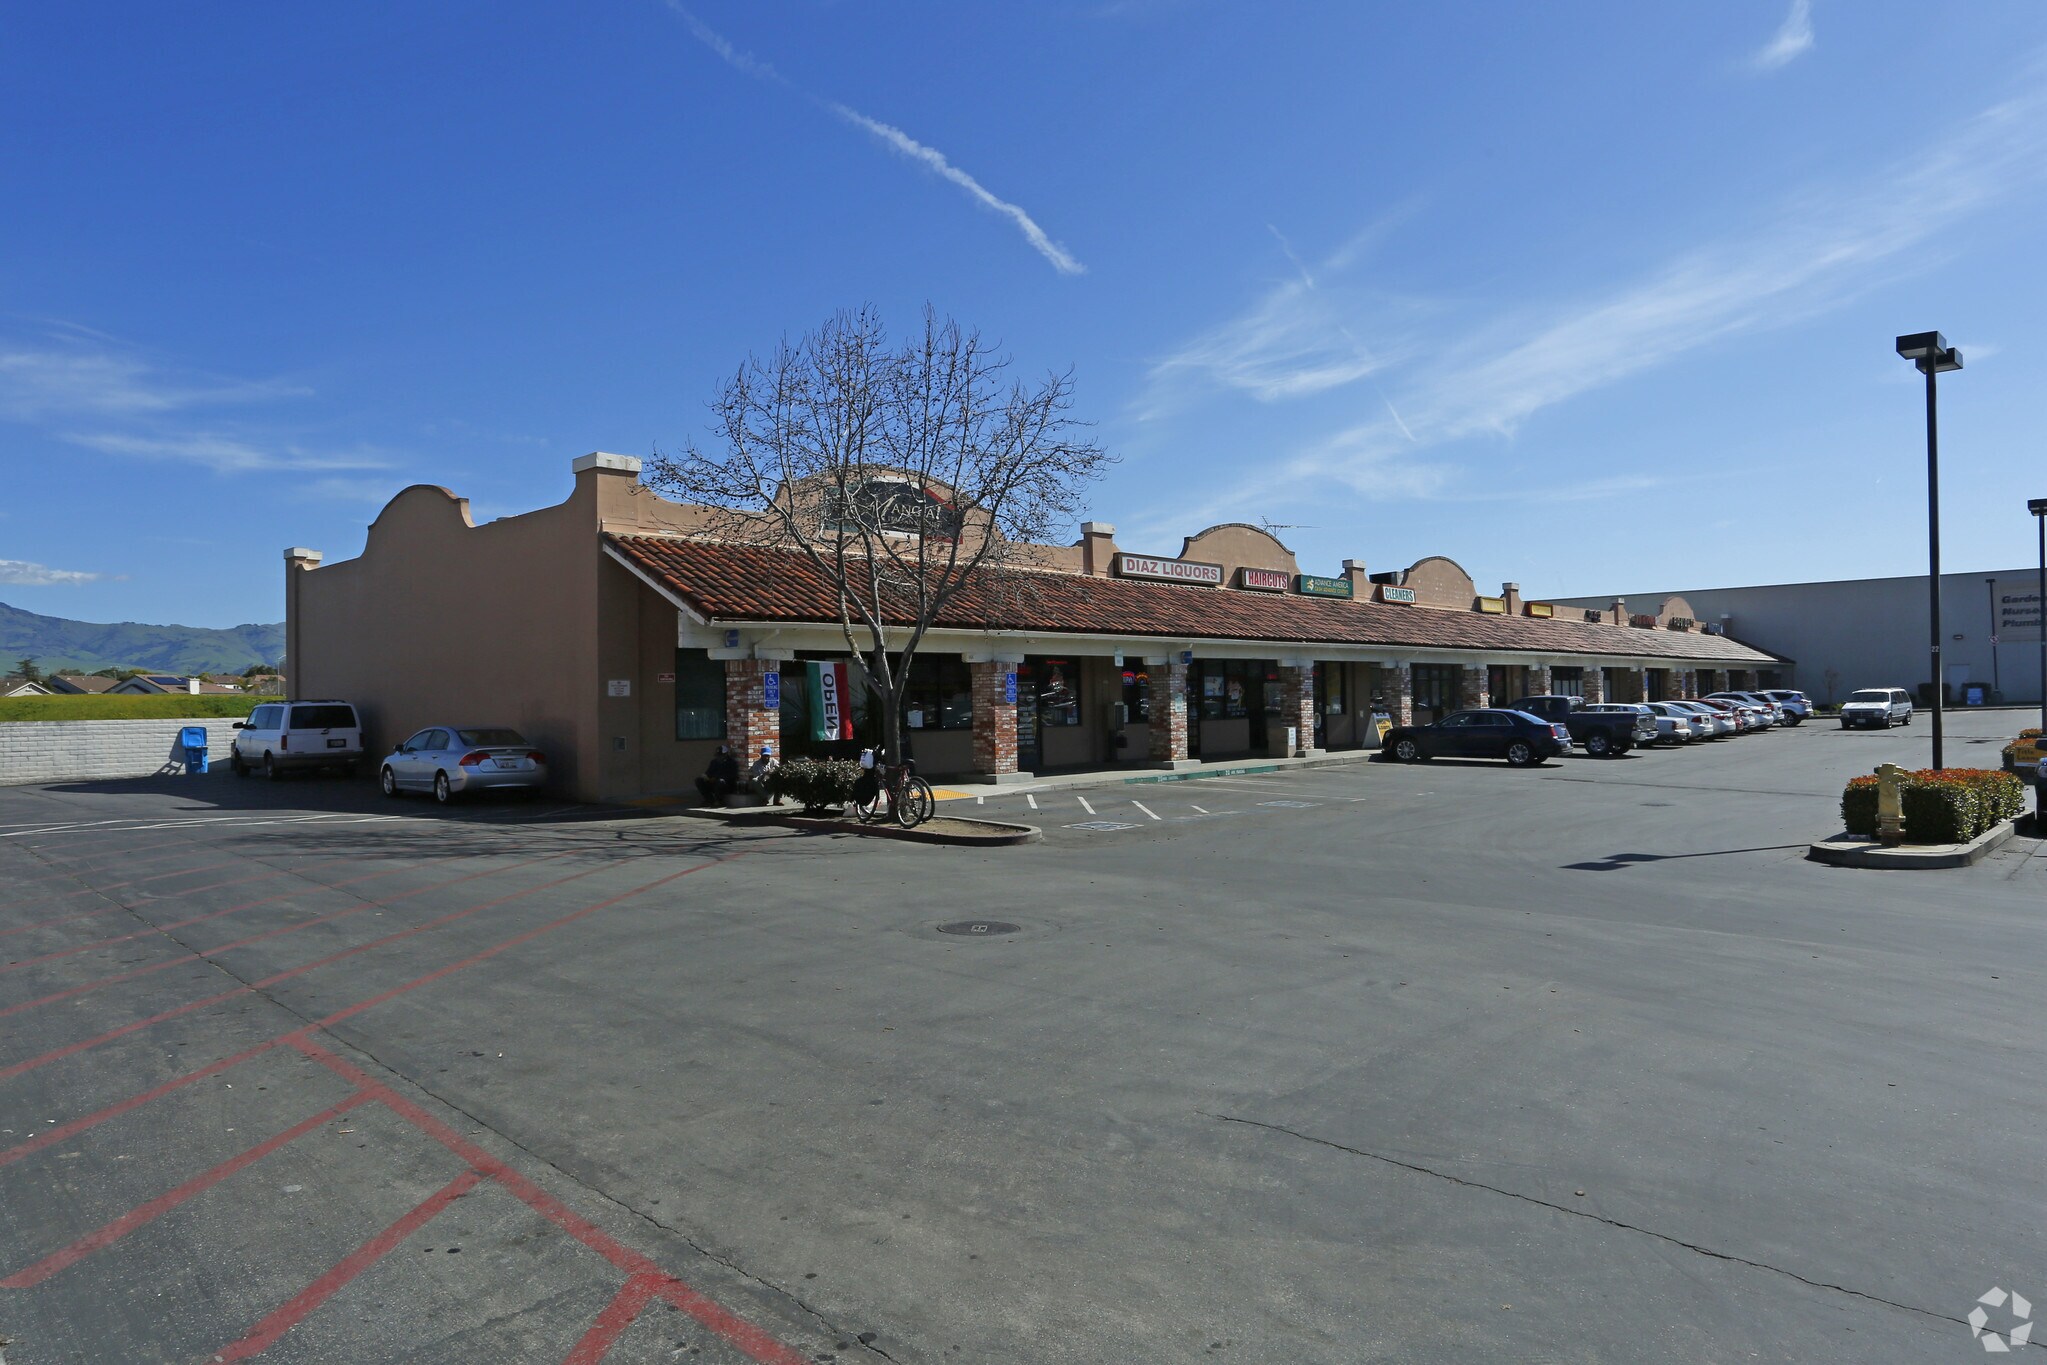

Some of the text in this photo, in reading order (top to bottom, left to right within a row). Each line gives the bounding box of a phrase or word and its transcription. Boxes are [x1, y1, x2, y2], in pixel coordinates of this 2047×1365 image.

[1126, 558, 1218, 580] DIAZ LIQUORS
[1248, 571, 1287, 589] HAIRCUTS
[1384, 587, 1413, 602] CLEANERS
[2001, 594, 2041, 604] Garde
[2001, 607, 2040, 616] Nurse
